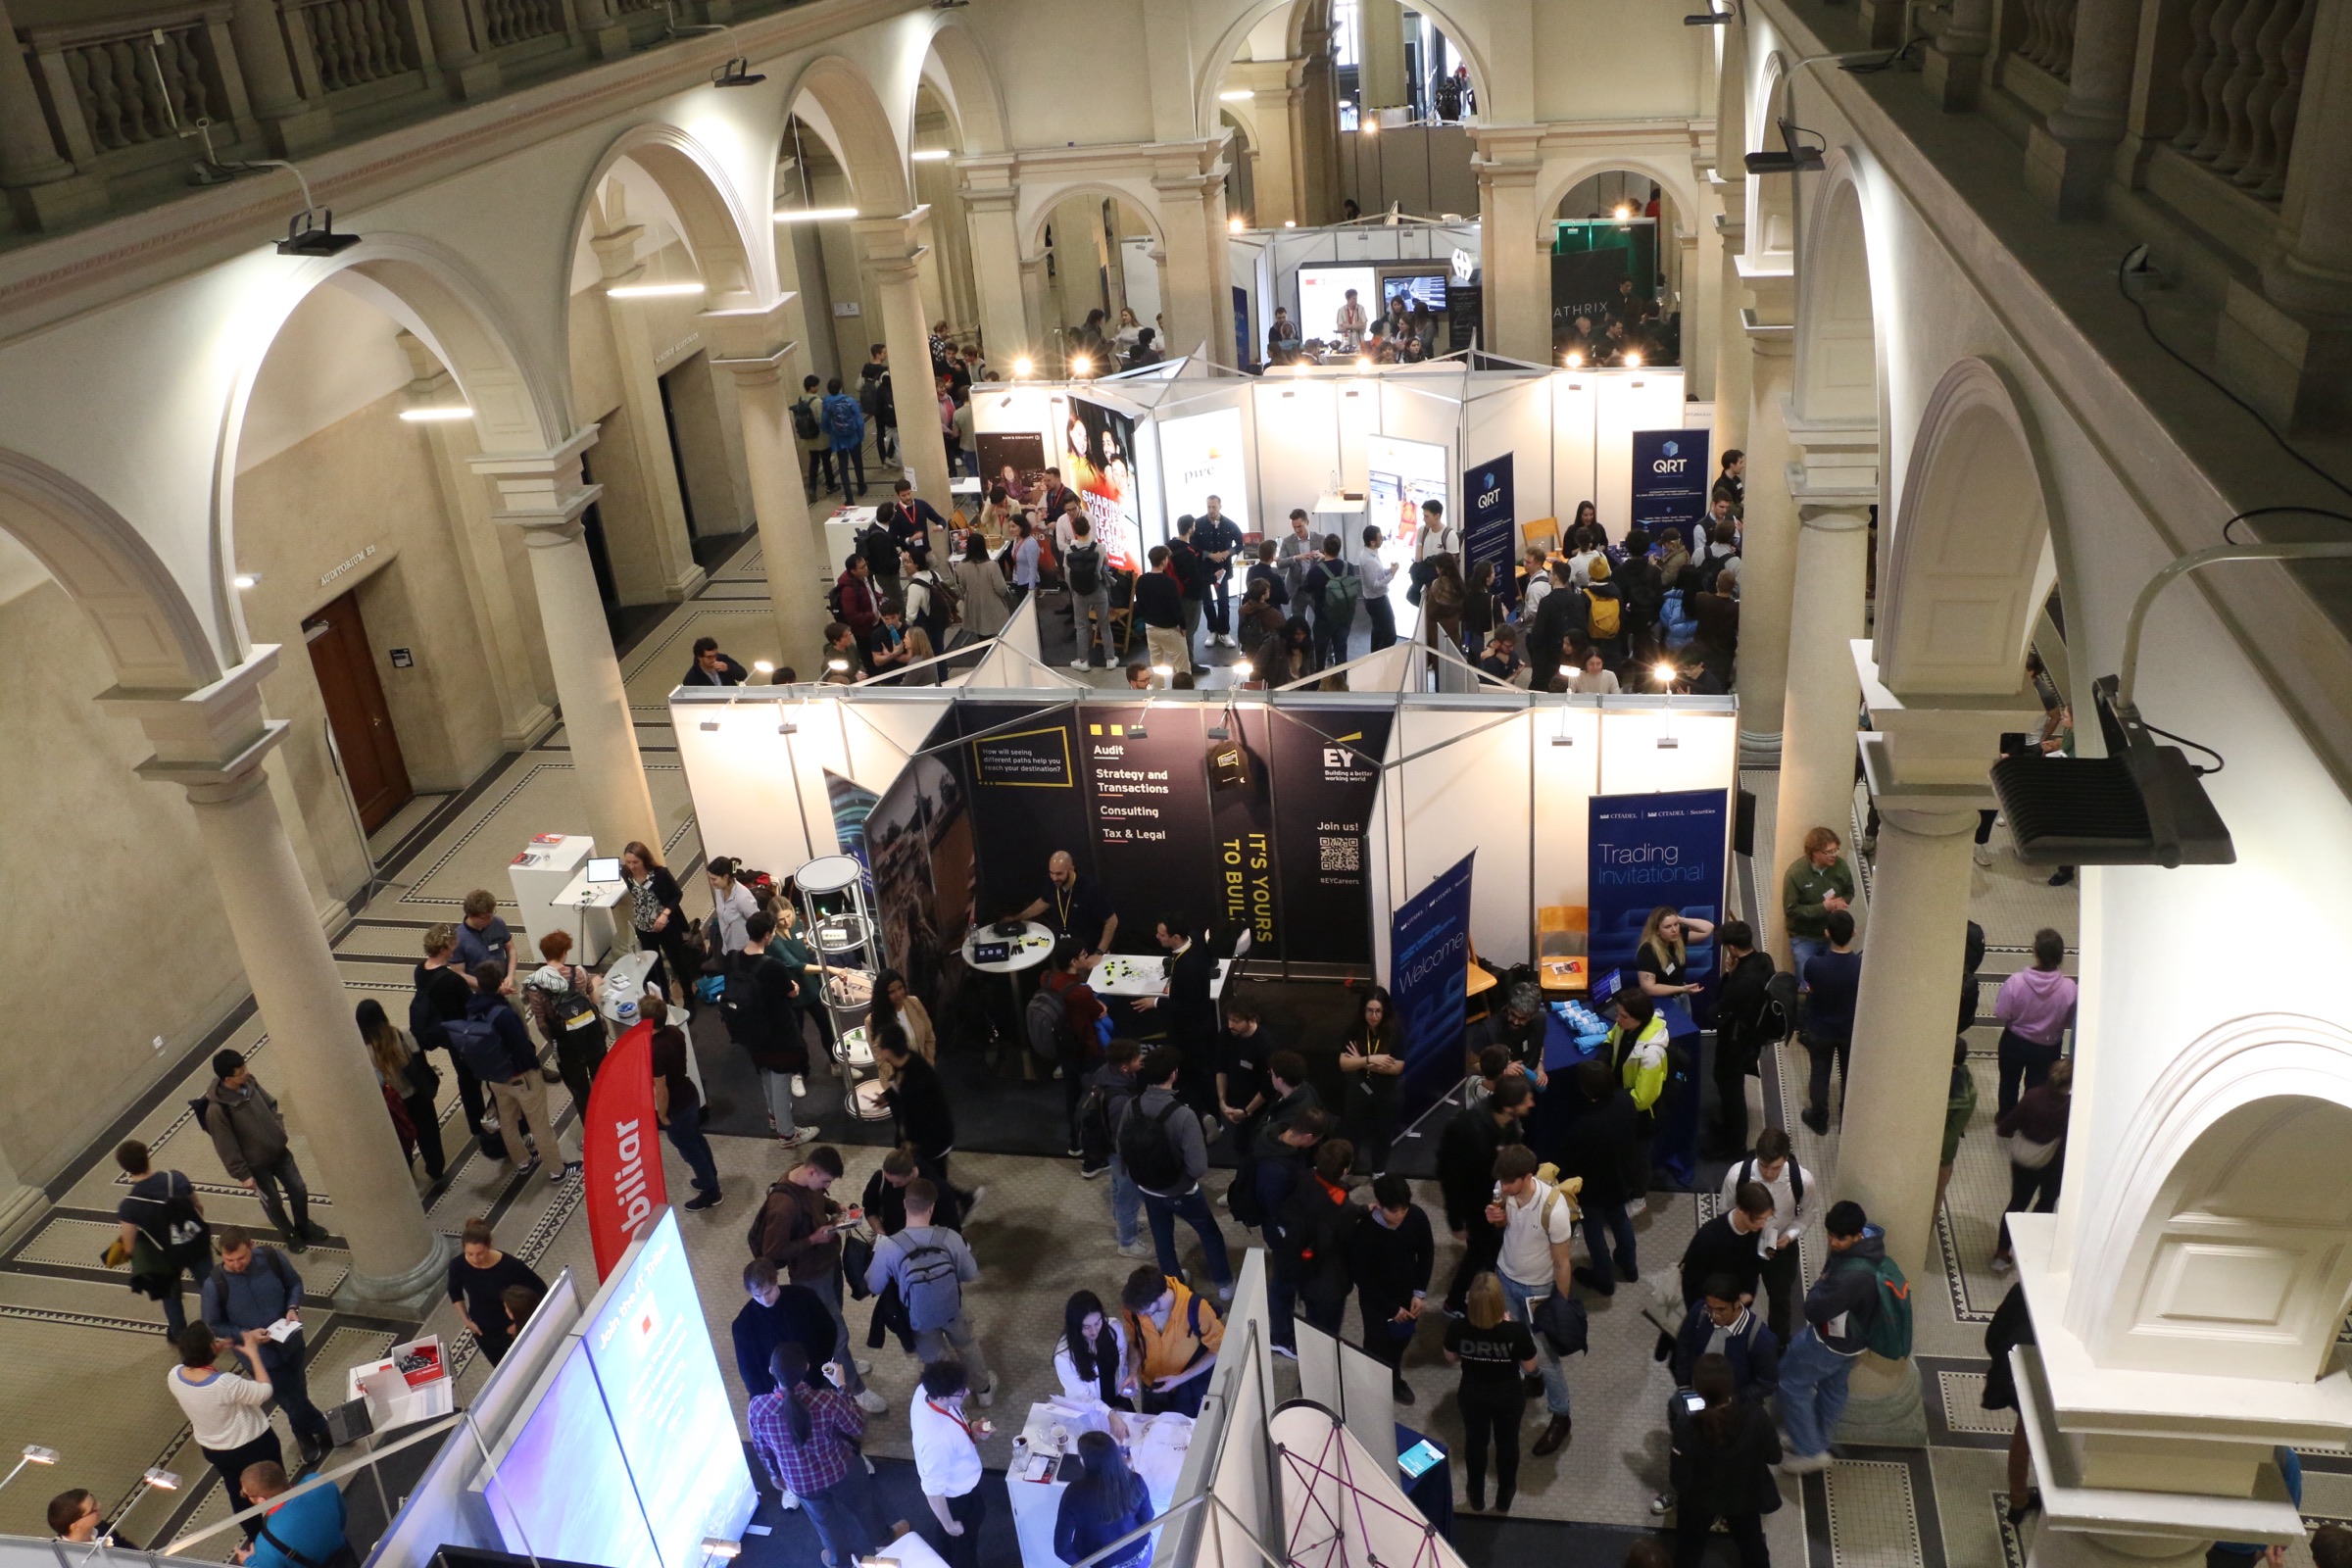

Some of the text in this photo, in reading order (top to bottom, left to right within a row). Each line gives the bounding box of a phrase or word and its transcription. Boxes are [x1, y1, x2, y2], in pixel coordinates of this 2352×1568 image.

[1183, 466, 1214, 484] pwc
[1652, 459, 1688, 474] QRT
[1478, 488, 1501, 510] QRT
[320, 551, 366, 587] AUDITORIUM
[1093, 745, 1125, 756] Audit
[1323, 748, 1354, 768] EY
[1096, 768, 1168, 782] Strategy and
[1097, 782, 1169, 794] Transactions
[1100, 806, 1159, 819] Consulting
[1102, 828, 1166, 843] Tax & Legal
[1317, 821, 1359, 832] Join us!
[1597, 843, 1679, 865] Trading
[1223, 839, 1247, 922] TO BUIL
[1320, 877, 1360, 886] #EYCareers
[1597, 861, 1704, 886] Invitational
[1249, 833, 1274, 944] IT'S YOURS
[1398, 931, 1464, 995] Welcome
[601, 1316, 620, 1350] Join
[619, 1292, 636, 1317] the
[634, 1272, 645, 1294] IT
[1460, 1339, 1514, 1358] DRW
